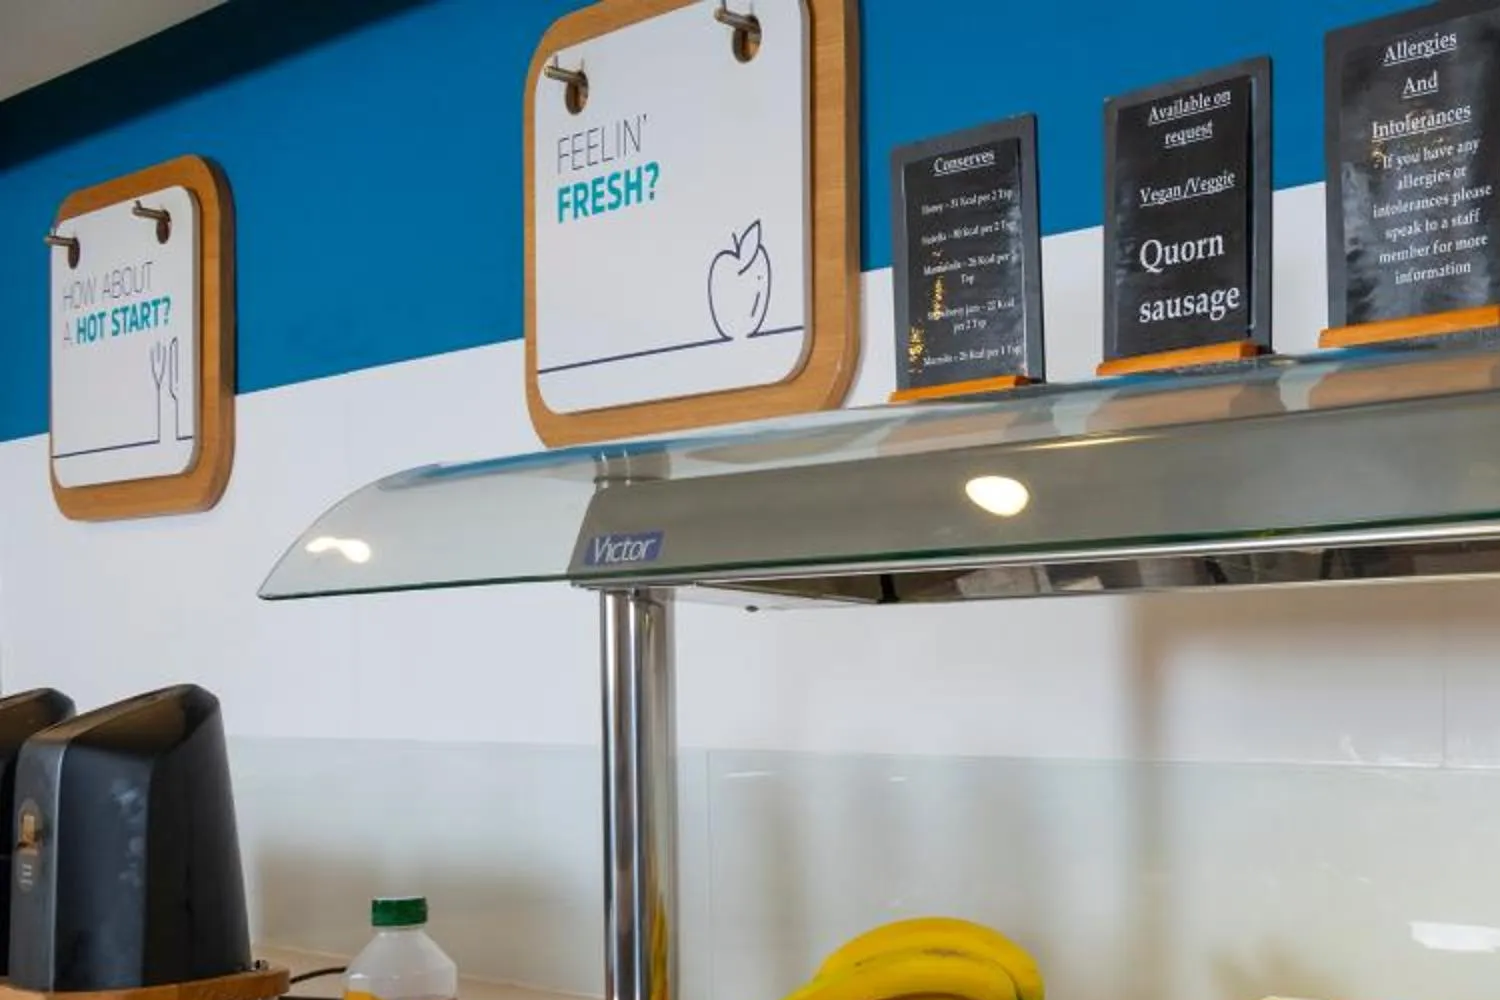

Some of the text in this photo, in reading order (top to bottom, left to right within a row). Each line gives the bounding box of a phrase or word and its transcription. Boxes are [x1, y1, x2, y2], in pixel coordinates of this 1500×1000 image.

[1384, 32, 1458, 63] Allergies
[1402, 71, 1439, 95] And
[1148, 89, 1232, 122] Available on
[1371, 104, 1472, 138] Intolerances
[1164, 120, 1214, 146] request
[933, 149, 996, 174] Conserves
[1395, 151, 1420, 171] you
[1423, 145, 1455, 161] have
[1457, 139, 1481, 154] any
[557, 161, 661, 224] FRESH?
[1397, 167, 1451, 191] allergies
[1373, 184, 1493, 218] intolerances please
[1385, 208, 1481, 242] speak to a staff
[1139, 233, 1225, 273] Quorn
[1379, 235, 1489, 262] member for more
[63, 261, 153, 312] HOW ABOUT
[1395, 261, 1472, 285] information
[76, 311, 107, 344] HOT
[111, 295, 171, 337] START?
[1139, 286, 1241, 324] sausage
[594, 536, 657, 563] Victor
